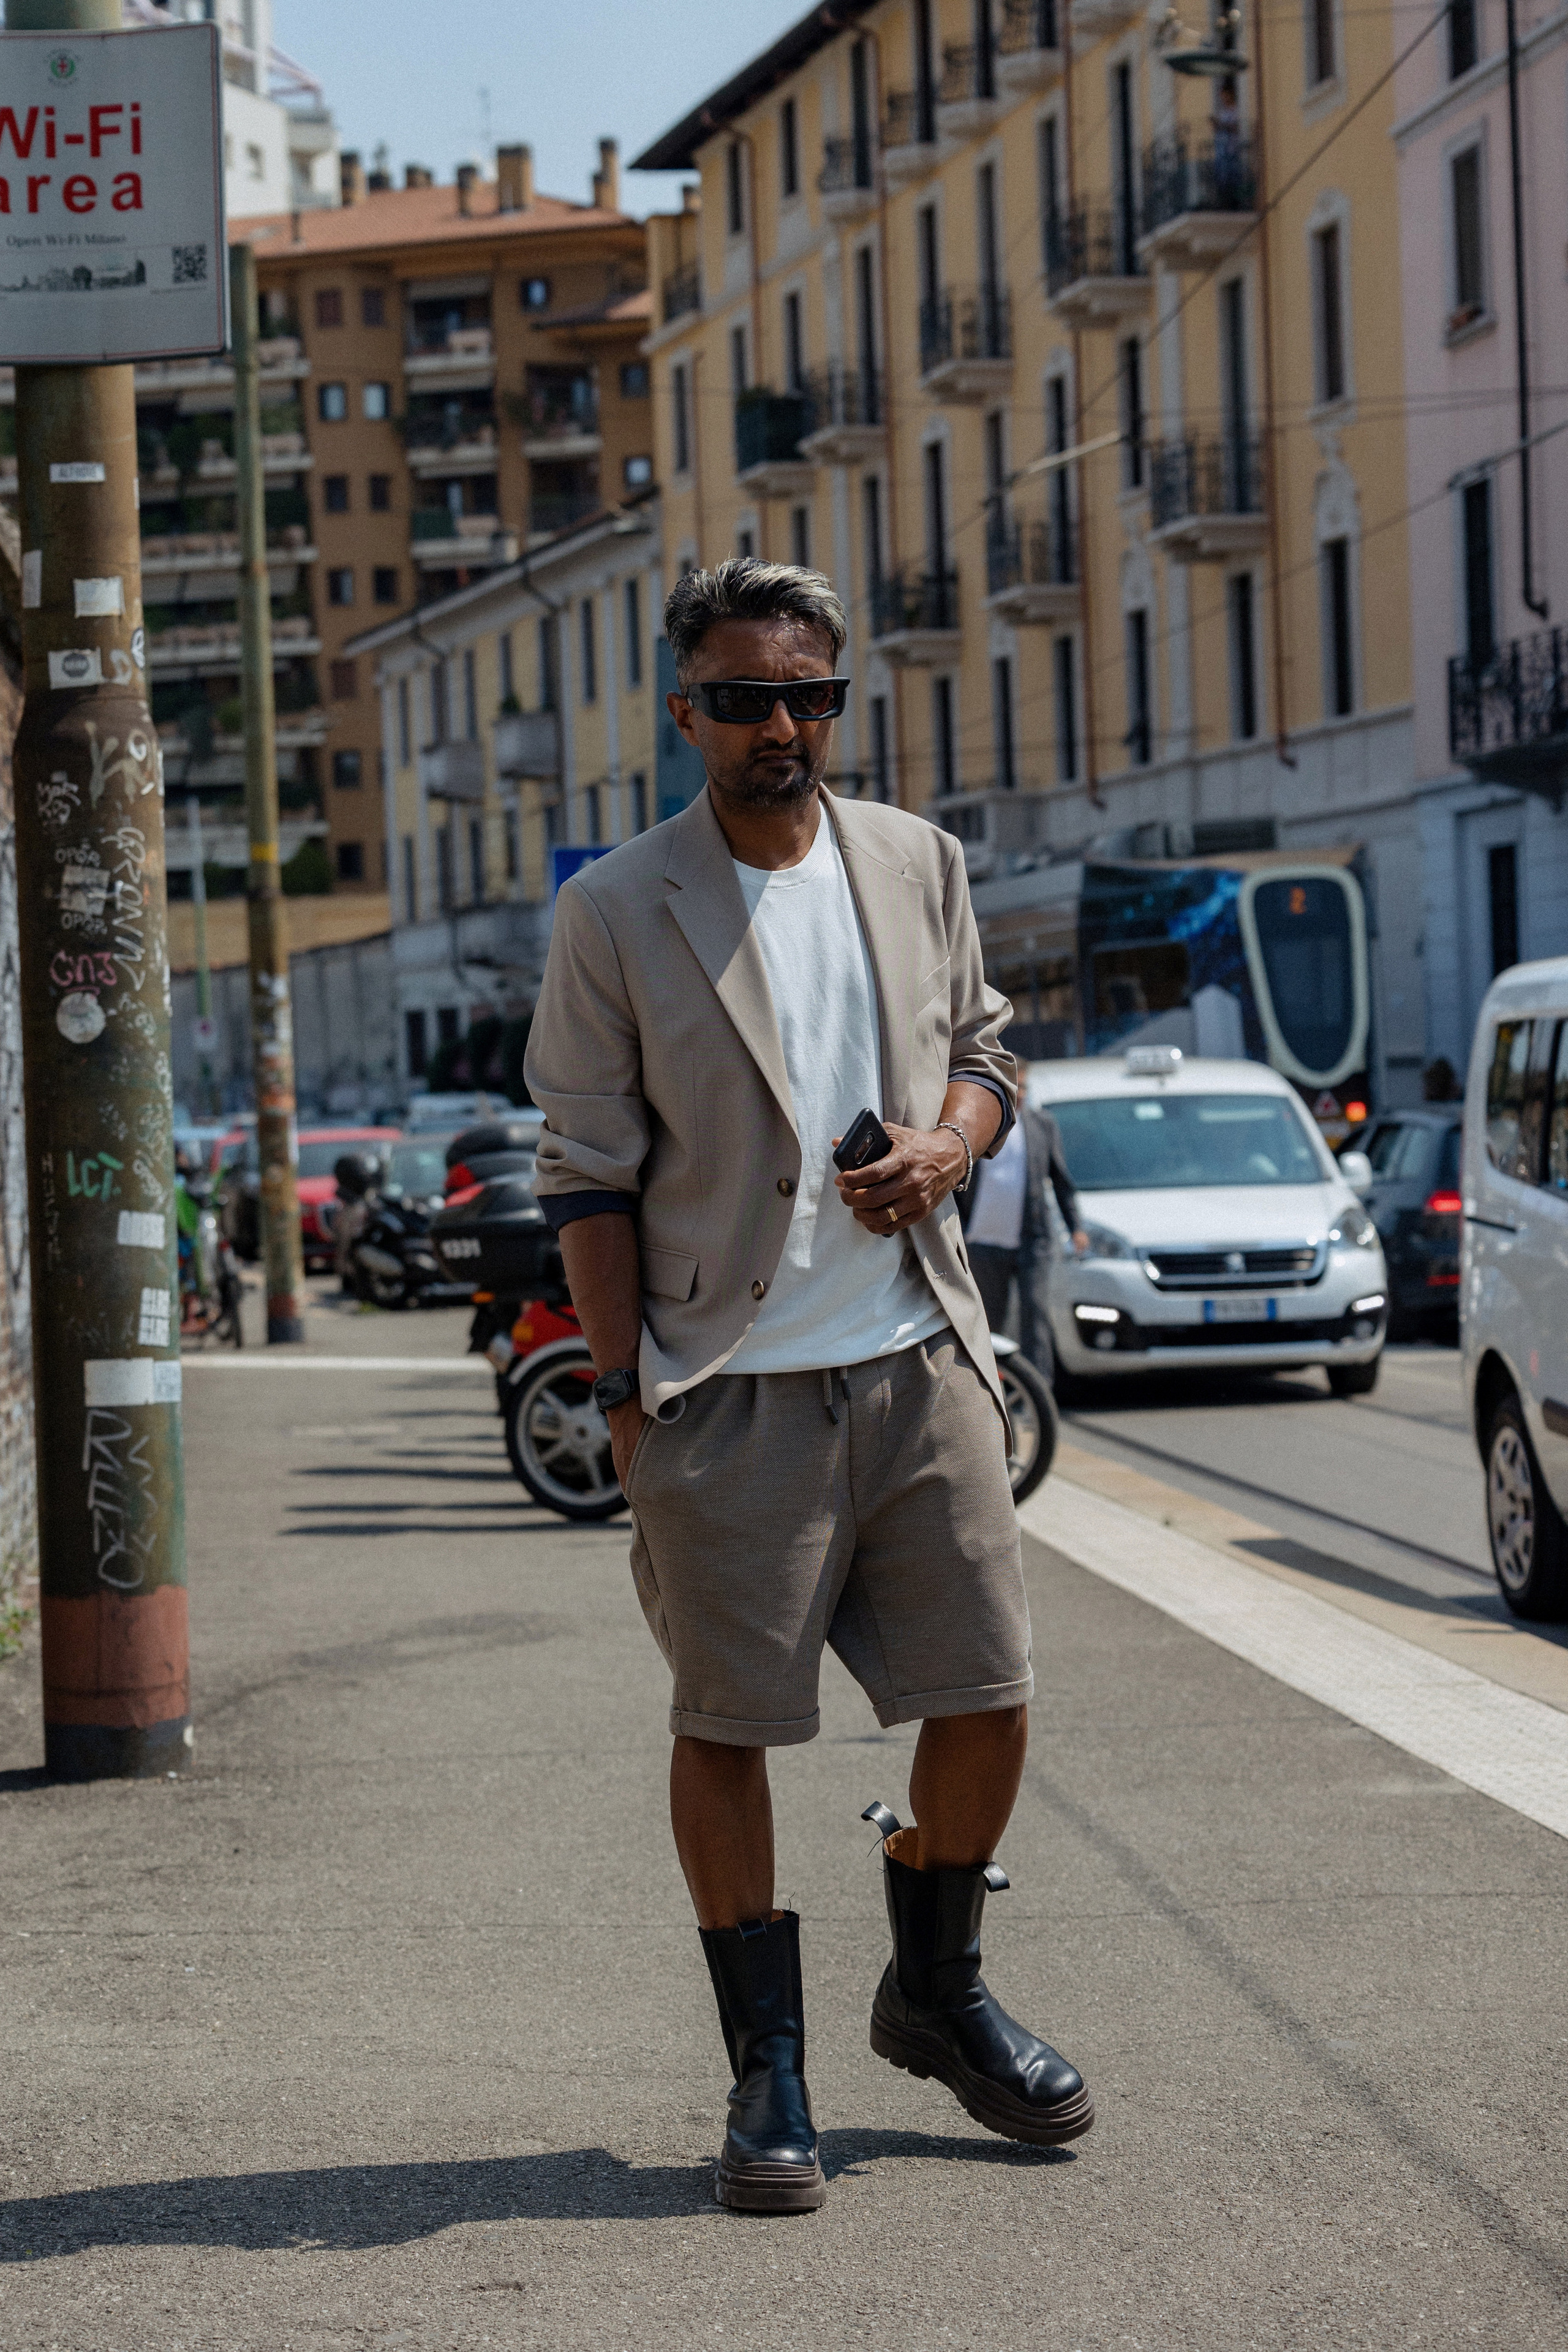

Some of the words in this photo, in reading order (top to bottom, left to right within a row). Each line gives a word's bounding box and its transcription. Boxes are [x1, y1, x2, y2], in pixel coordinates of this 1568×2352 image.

[0, 102, 141, 159] Wi-Fi
[6, 235, 42, 248] Open
[1289, 886, 1307, 915] 2
